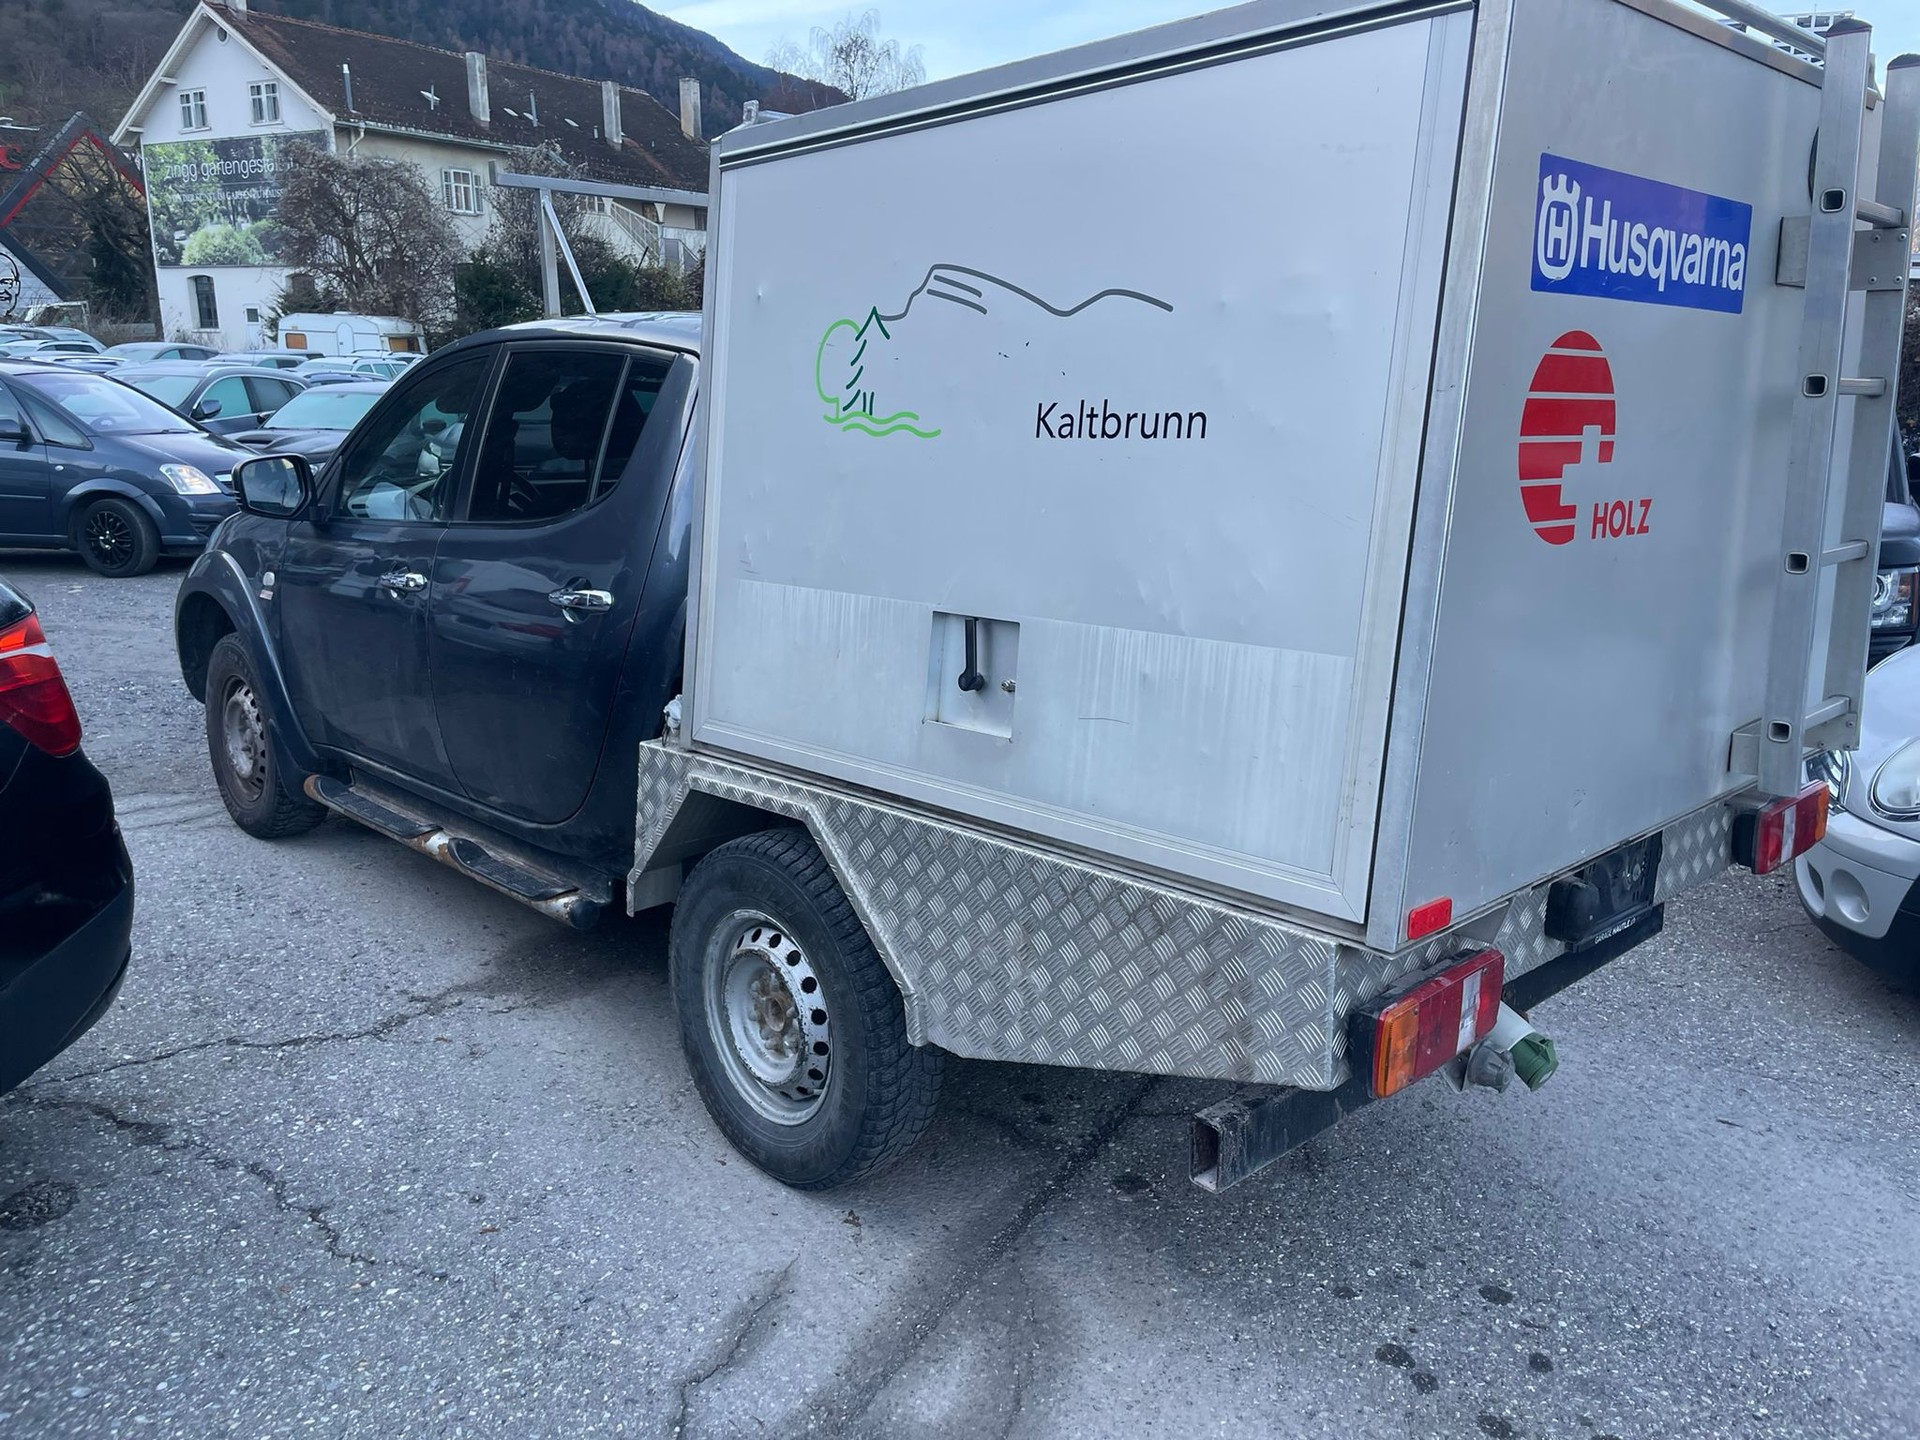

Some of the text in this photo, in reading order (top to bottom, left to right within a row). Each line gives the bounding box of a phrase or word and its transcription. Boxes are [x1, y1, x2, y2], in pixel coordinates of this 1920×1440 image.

[164, 163, 198, 182] zingg
[1580, 196, 1746, 292] Husqvarna
[1035, 399, 1207, 440] Kaltbrunn
[1591, 498, 1653, 540] HOLZ
